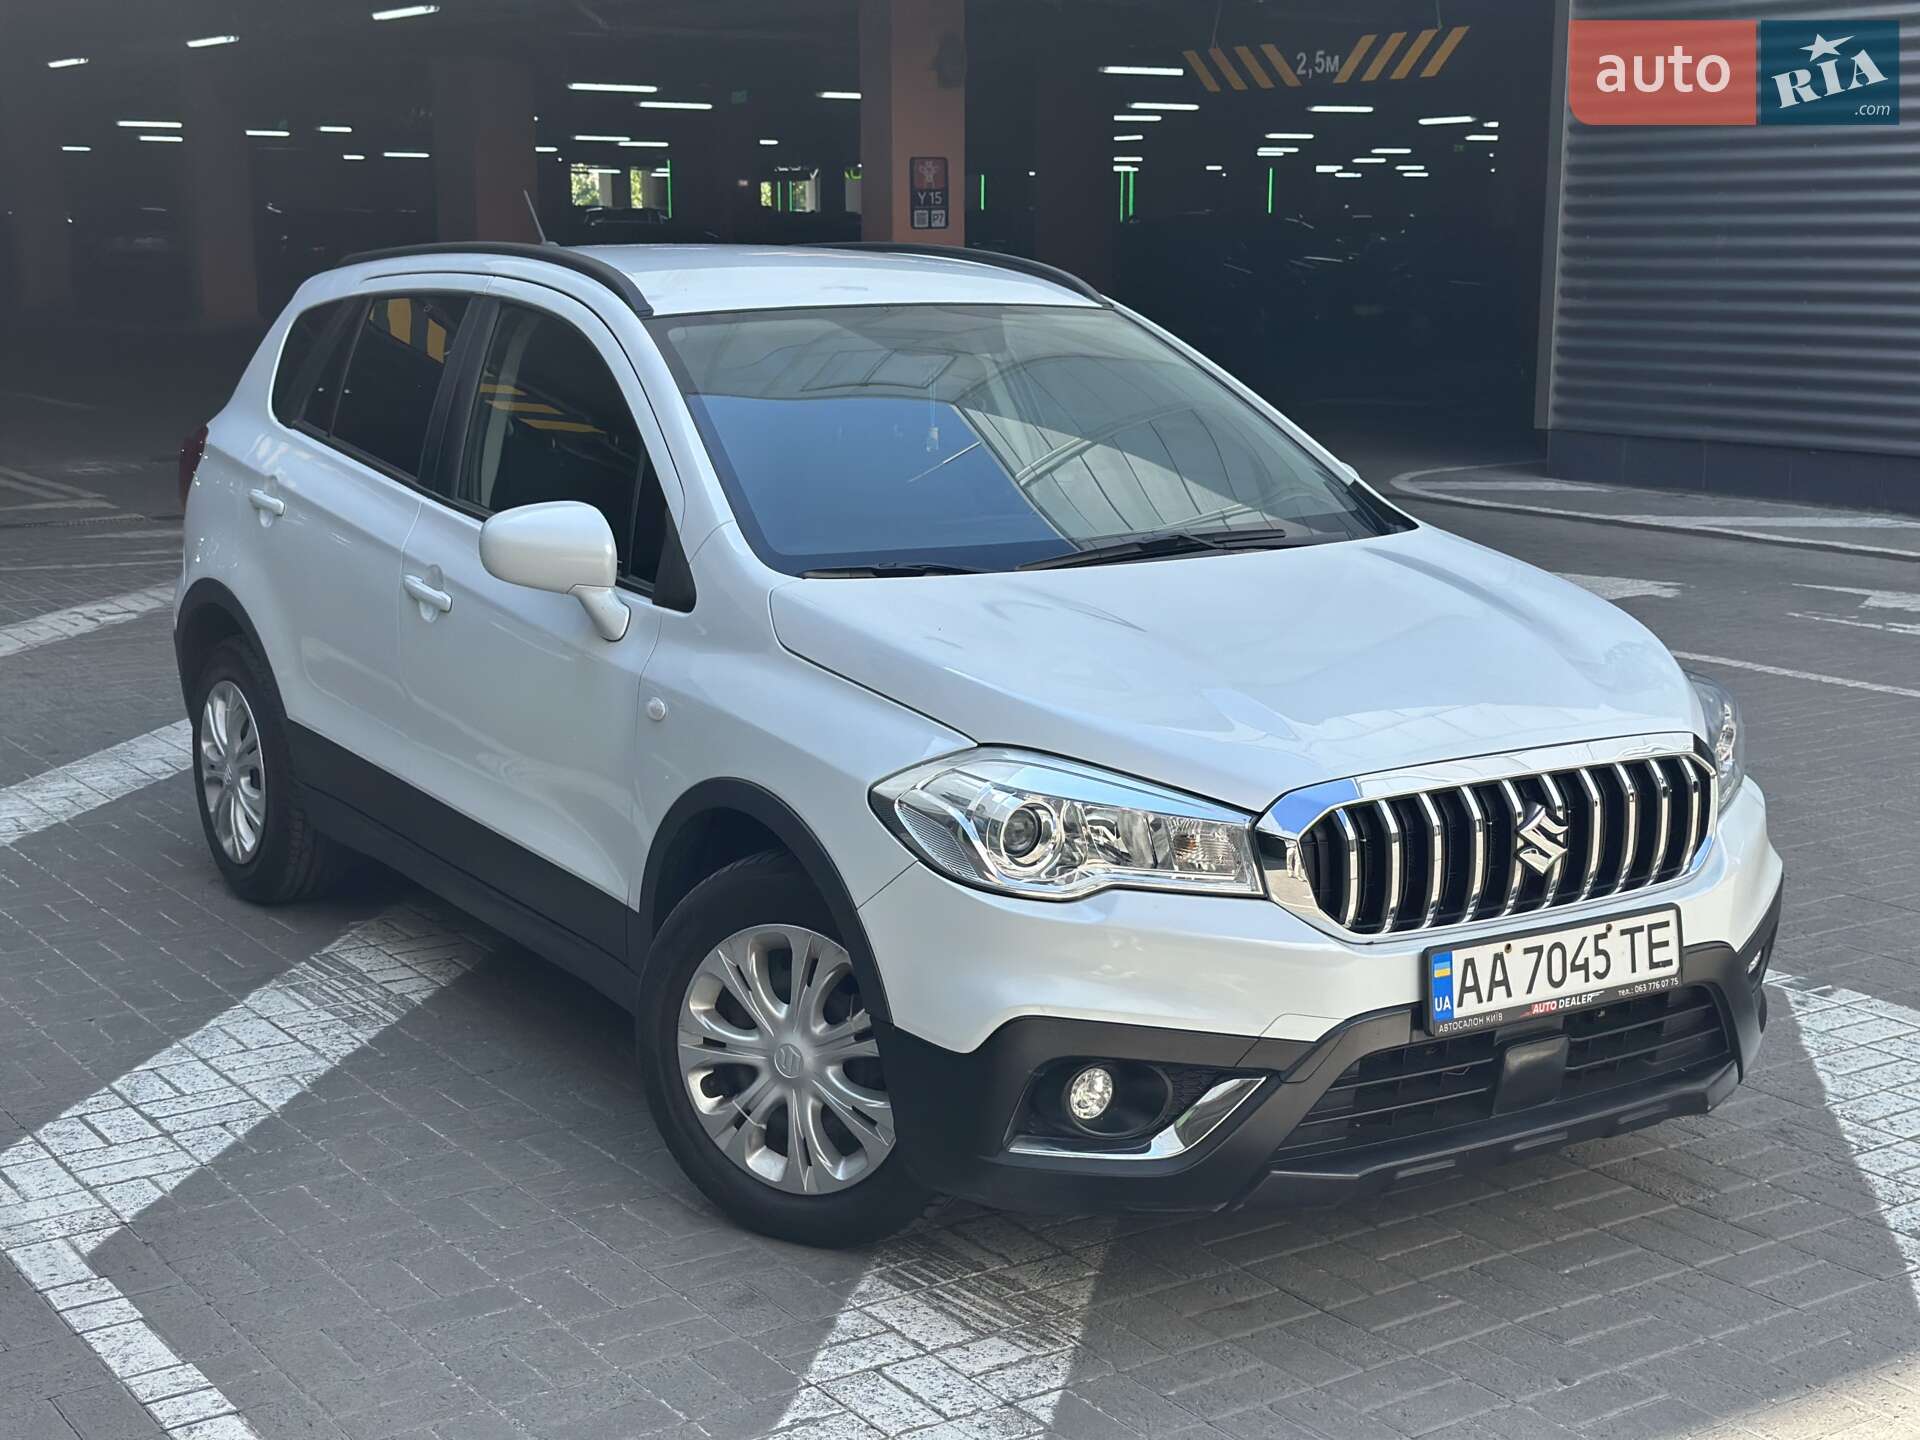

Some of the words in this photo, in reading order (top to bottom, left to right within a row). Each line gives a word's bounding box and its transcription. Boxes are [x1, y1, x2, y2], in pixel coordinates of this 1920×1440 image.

[917, 191, 927, 205] Y
[929, 191, 943, 205] 15
[1457, 952, 1513, 1008] AA
[1523, 933, 1611, 995] 7045
[1620, 920, 1673, 974] TE
[1634, 983, 1647, 993] 063
[1648, 980, 1661, 992] 776
[1661, 978, 1670, 988] 07
[1670, 976, 1679, 986] 75
[1434, 997, 1452, 1012] UA
[1532, 1000, 1558, 1015] AUTO
[1558, 993, 1594, 1009] DEALER
[1438, 1016, 1484, 1033] АВТОСАЛОН
